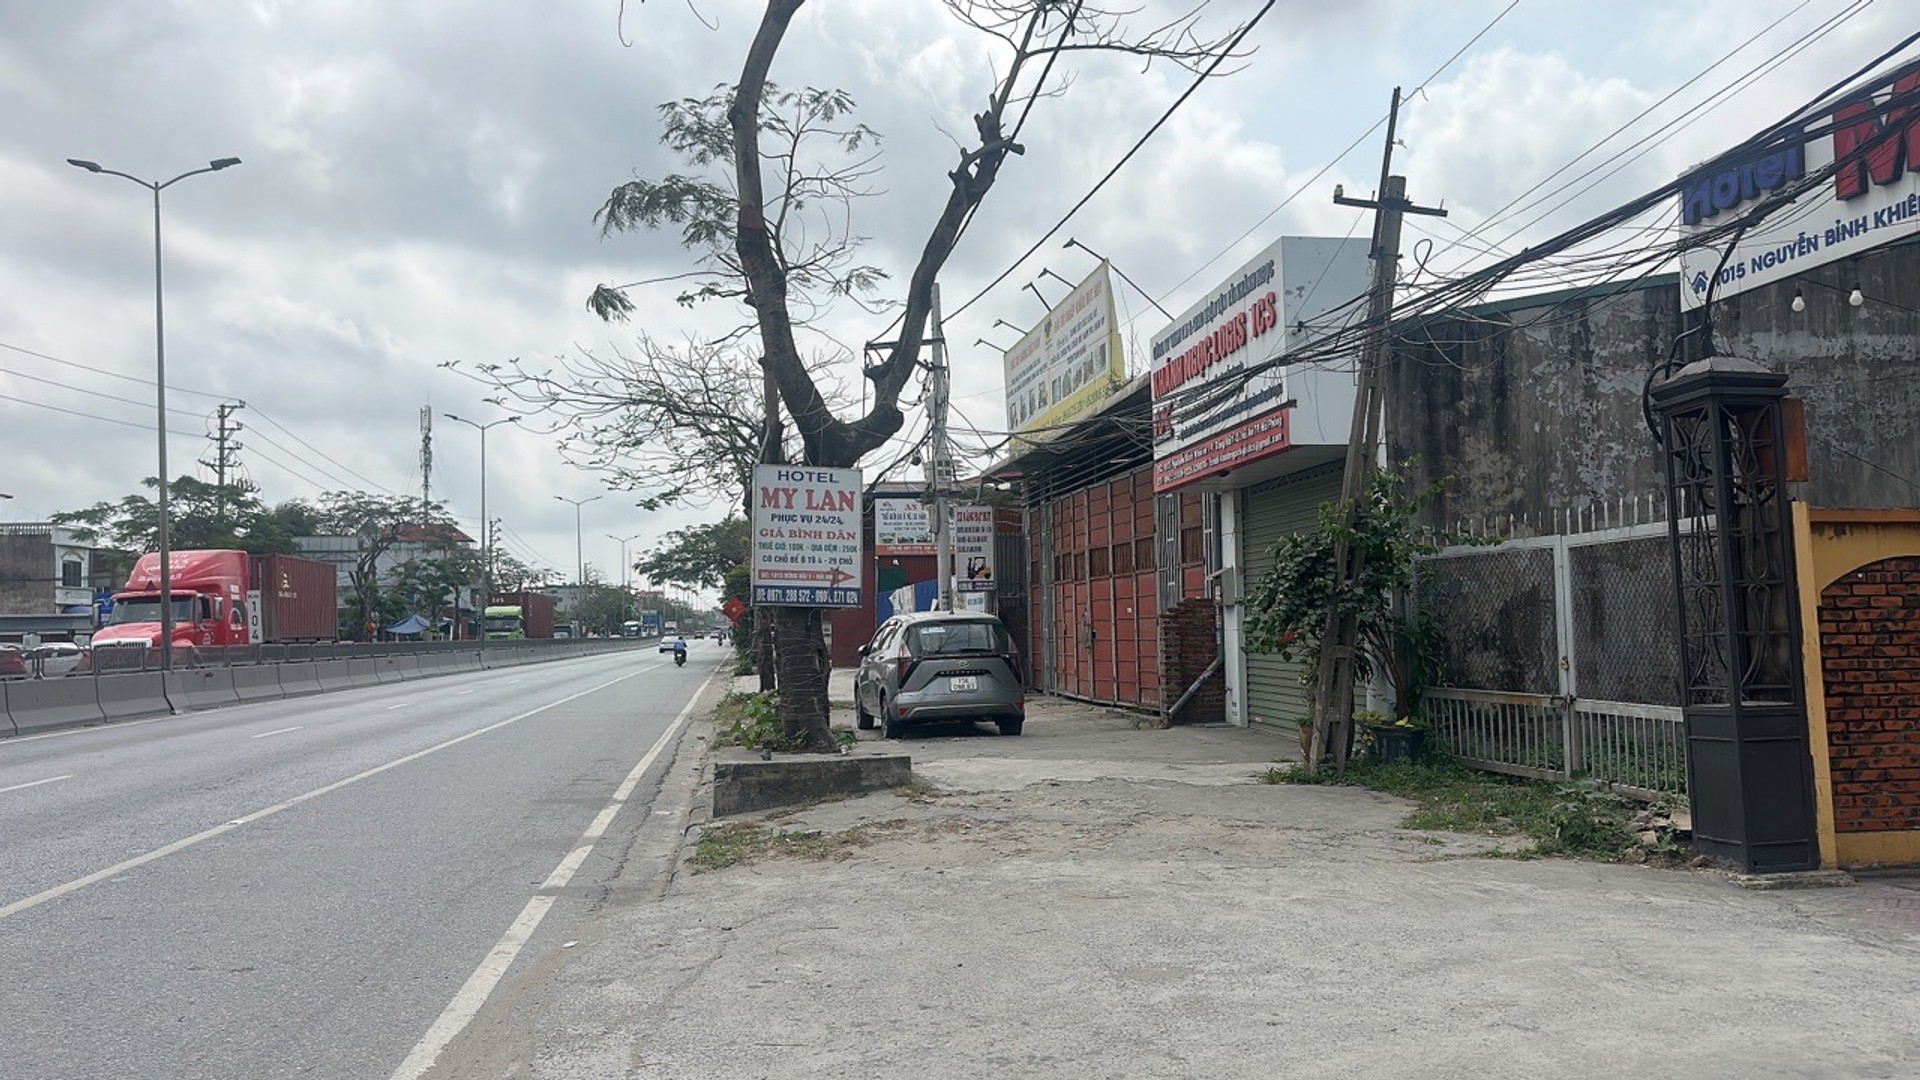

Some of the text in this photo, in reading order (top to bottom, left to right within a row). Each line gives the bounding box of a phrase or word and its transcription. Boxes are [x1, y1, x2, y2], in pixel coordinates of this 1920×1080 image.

[1751, 232, 1819, 274] NGUYỄN
[1873, 192, 1920, 229] KHIÊ
[778, 470, 839, 483] HOTEL
[761, 487, 856, 512] MY LAN
[771, 513, 797, 524] PHỤC
[800, 514, 813, 525] VỤ
[789, 527, 823, 539] BÌNH
